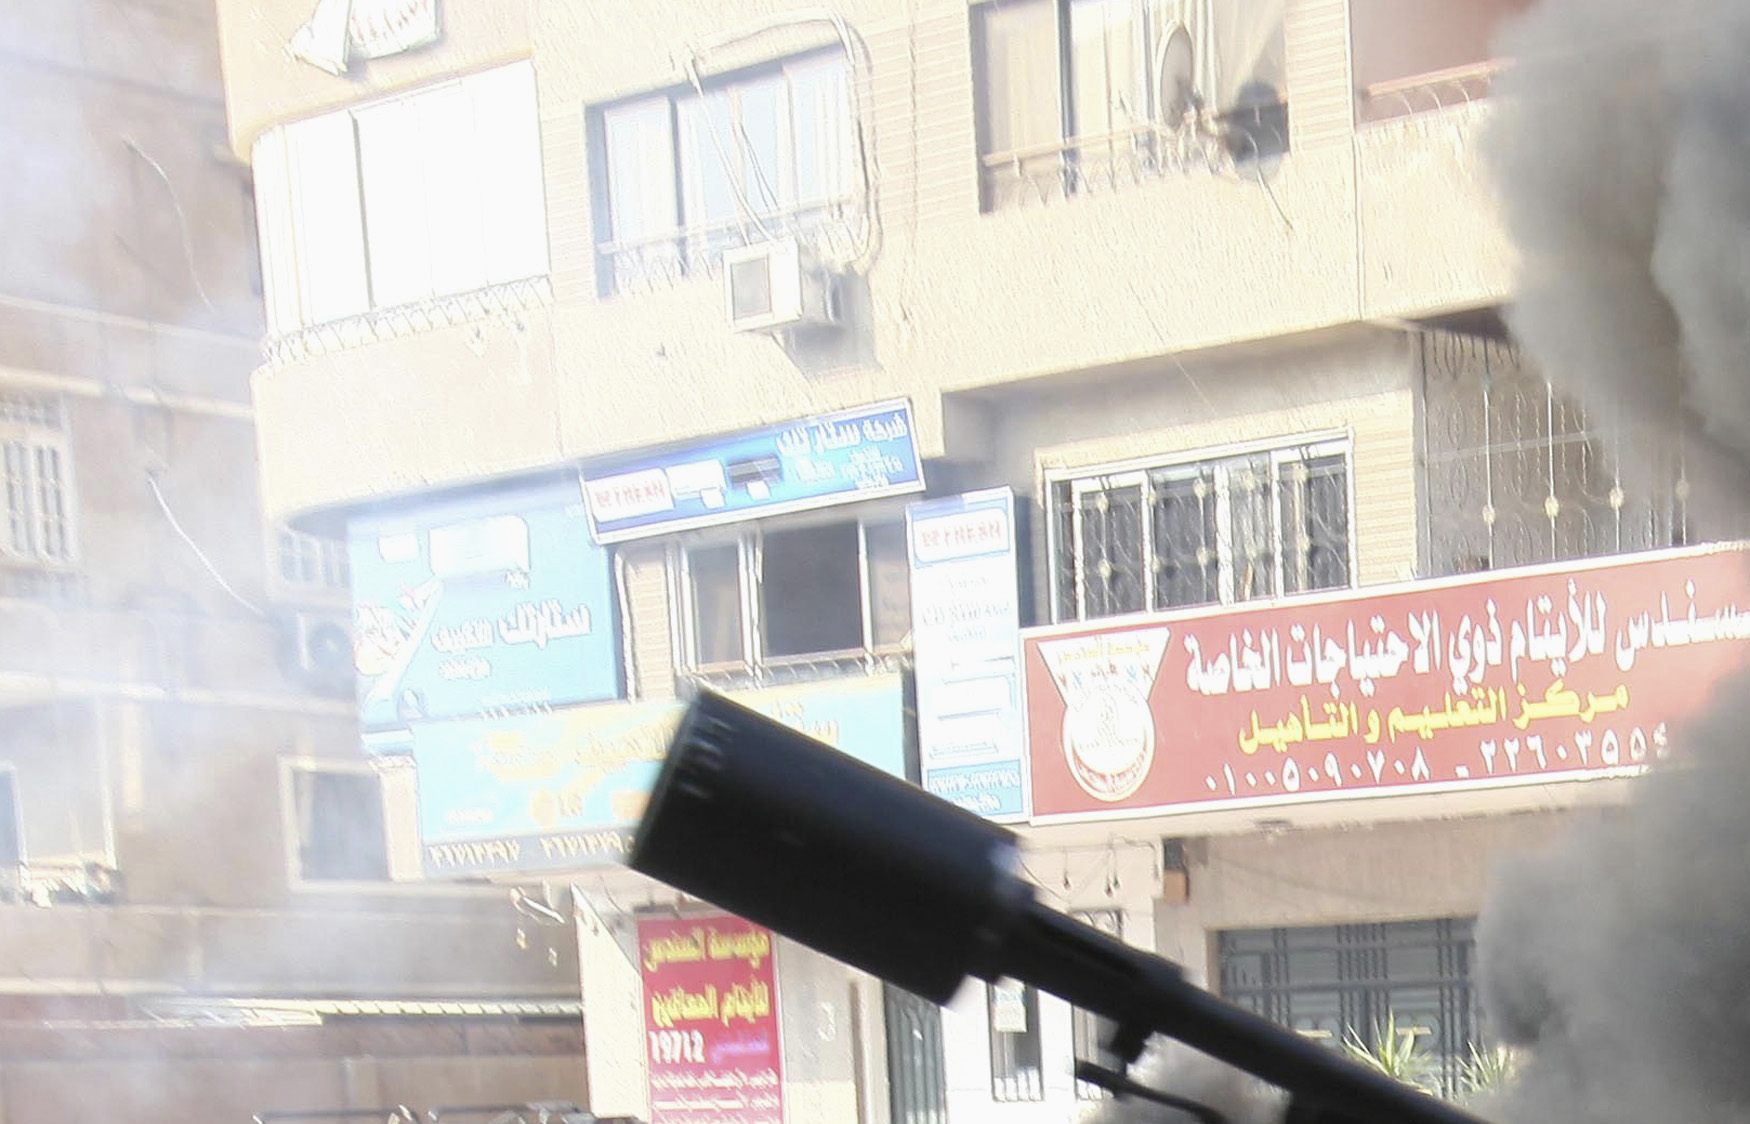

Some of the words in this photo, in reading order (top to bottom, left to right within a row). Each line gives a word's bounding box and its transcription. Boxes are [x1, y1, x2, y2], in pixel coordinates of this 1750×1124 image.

[1183, 626, 1282, 696] الخاصة
[1286, 609, 1441, 698] الاحتياجات
[1449, 598, 1503, 696] ذوي
[1510, 577, 1606, 683] للأيتام
[1238, 694, 1359, 756] التأهيل
[1386, 686, 1507, 743] التعليم
[1512, 678, 1630, 730] مركز
[648, 1029, 706, 1064] 19712
